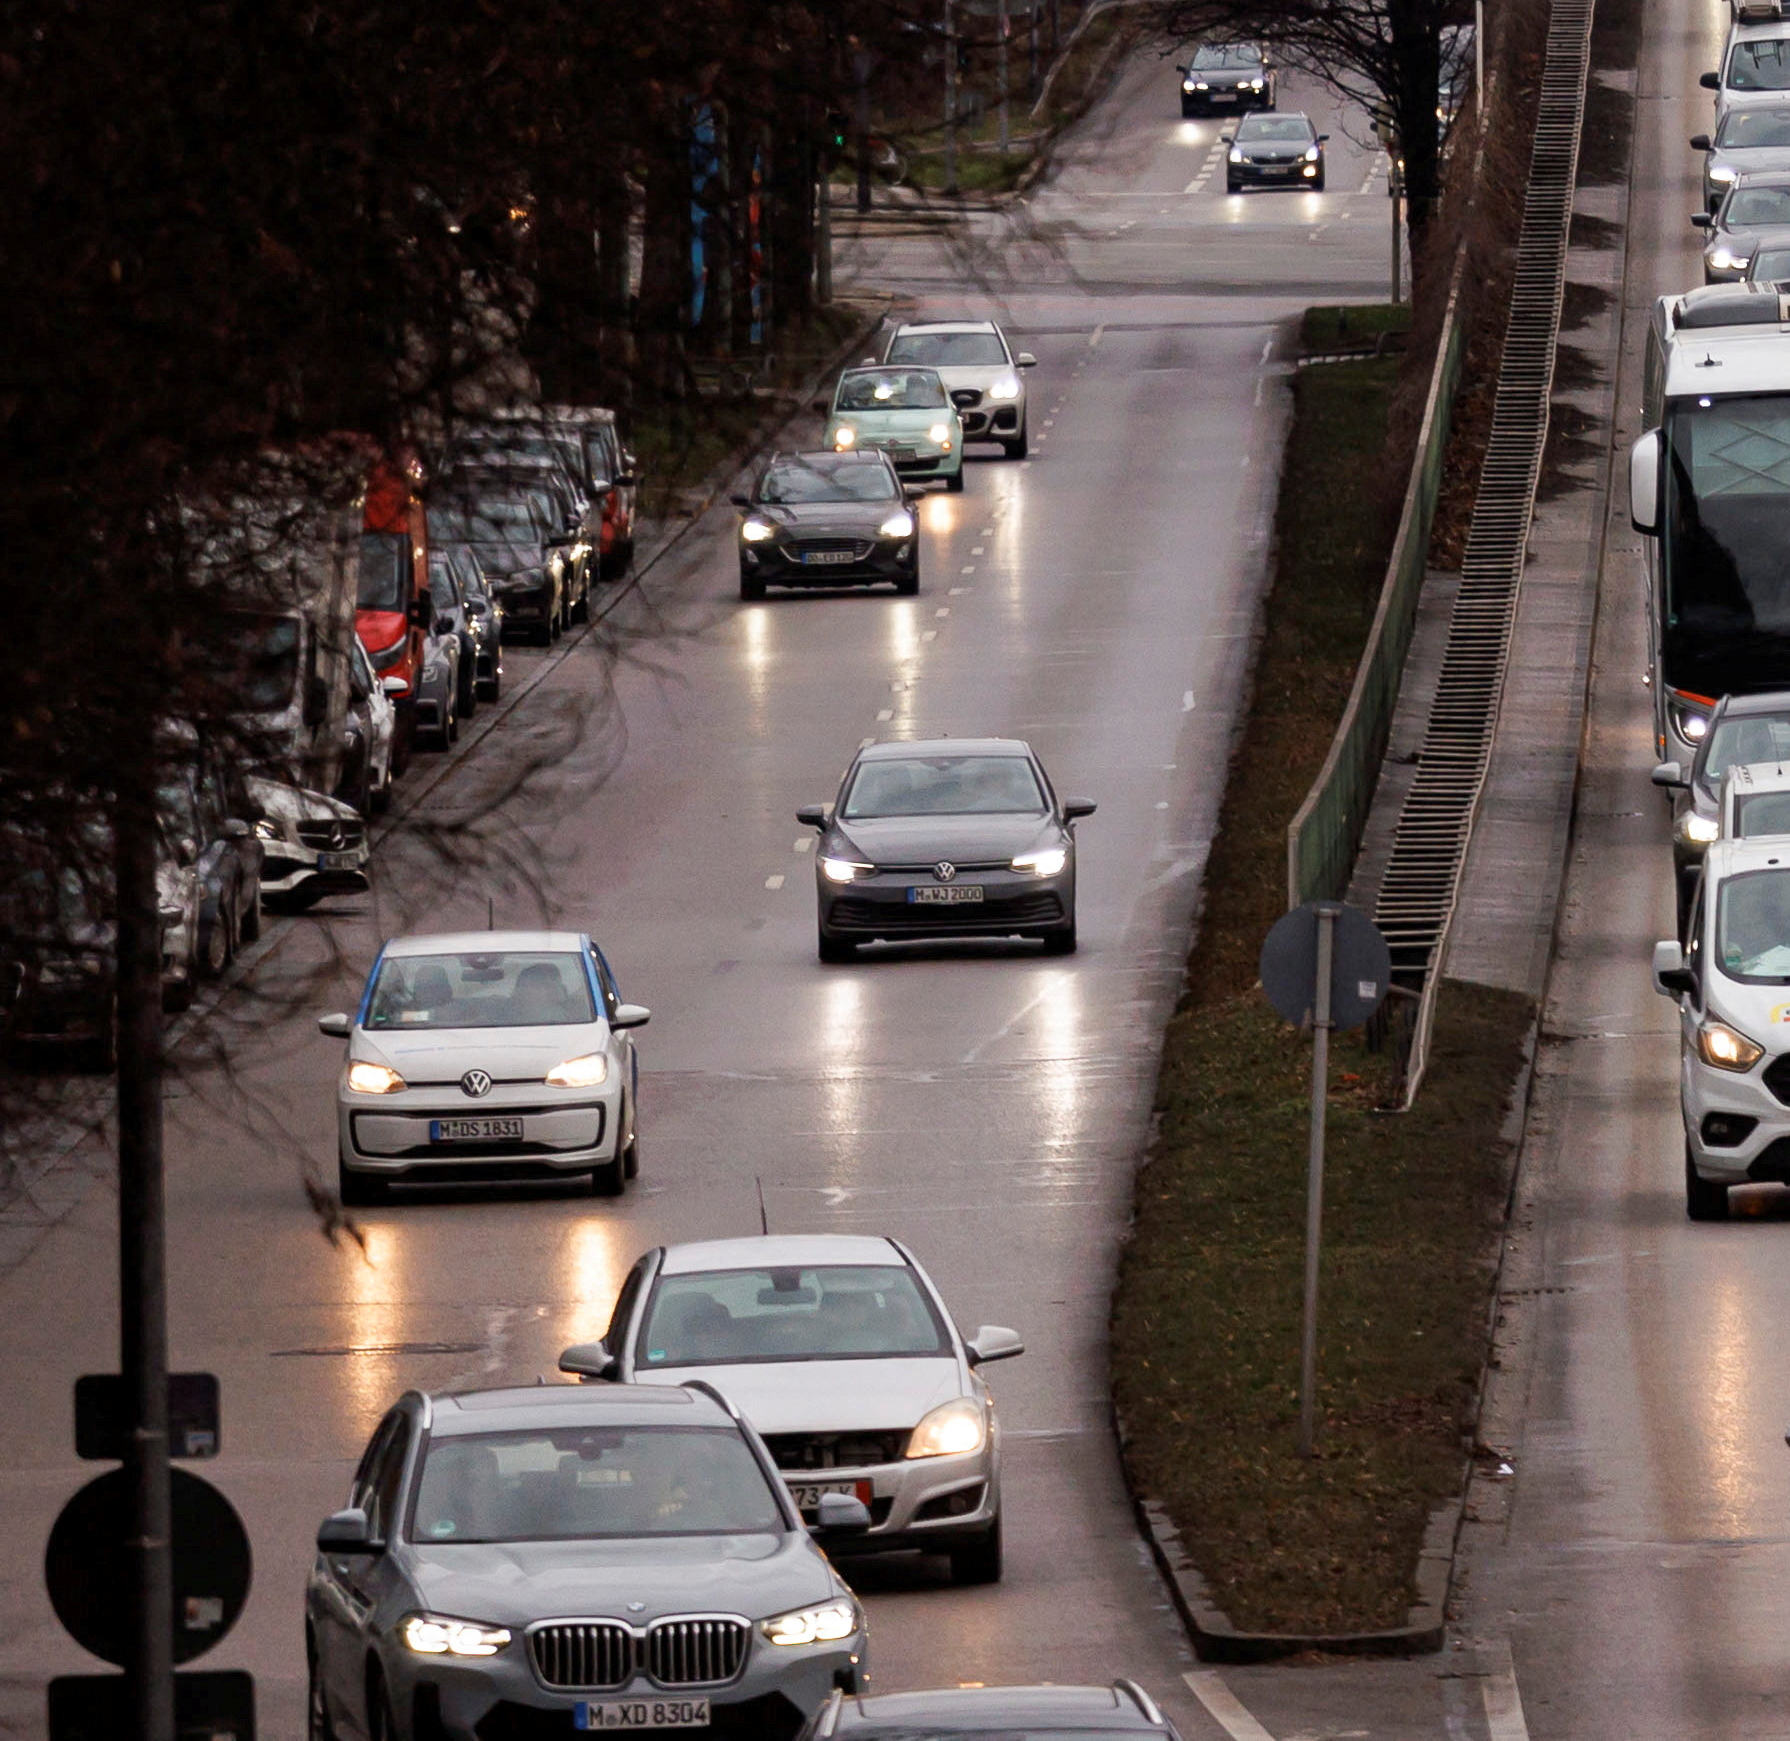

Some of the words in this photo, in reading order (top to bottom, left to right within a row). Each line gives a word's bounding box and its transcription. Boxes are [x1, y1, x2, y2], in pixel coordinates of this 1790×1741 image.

[915, 889, 924, 900] M
[952, 888, 982, 900] 2000
[440, 1123, 450, 1136] M
[460, 1122, 478, 1136] DS
[484, 1121, 520, 1135] 1831
[589, 1705, 603, 1726] M
[619, 1704, 647, 1725] XD
[653, 1702, 707, 1724] 8304
